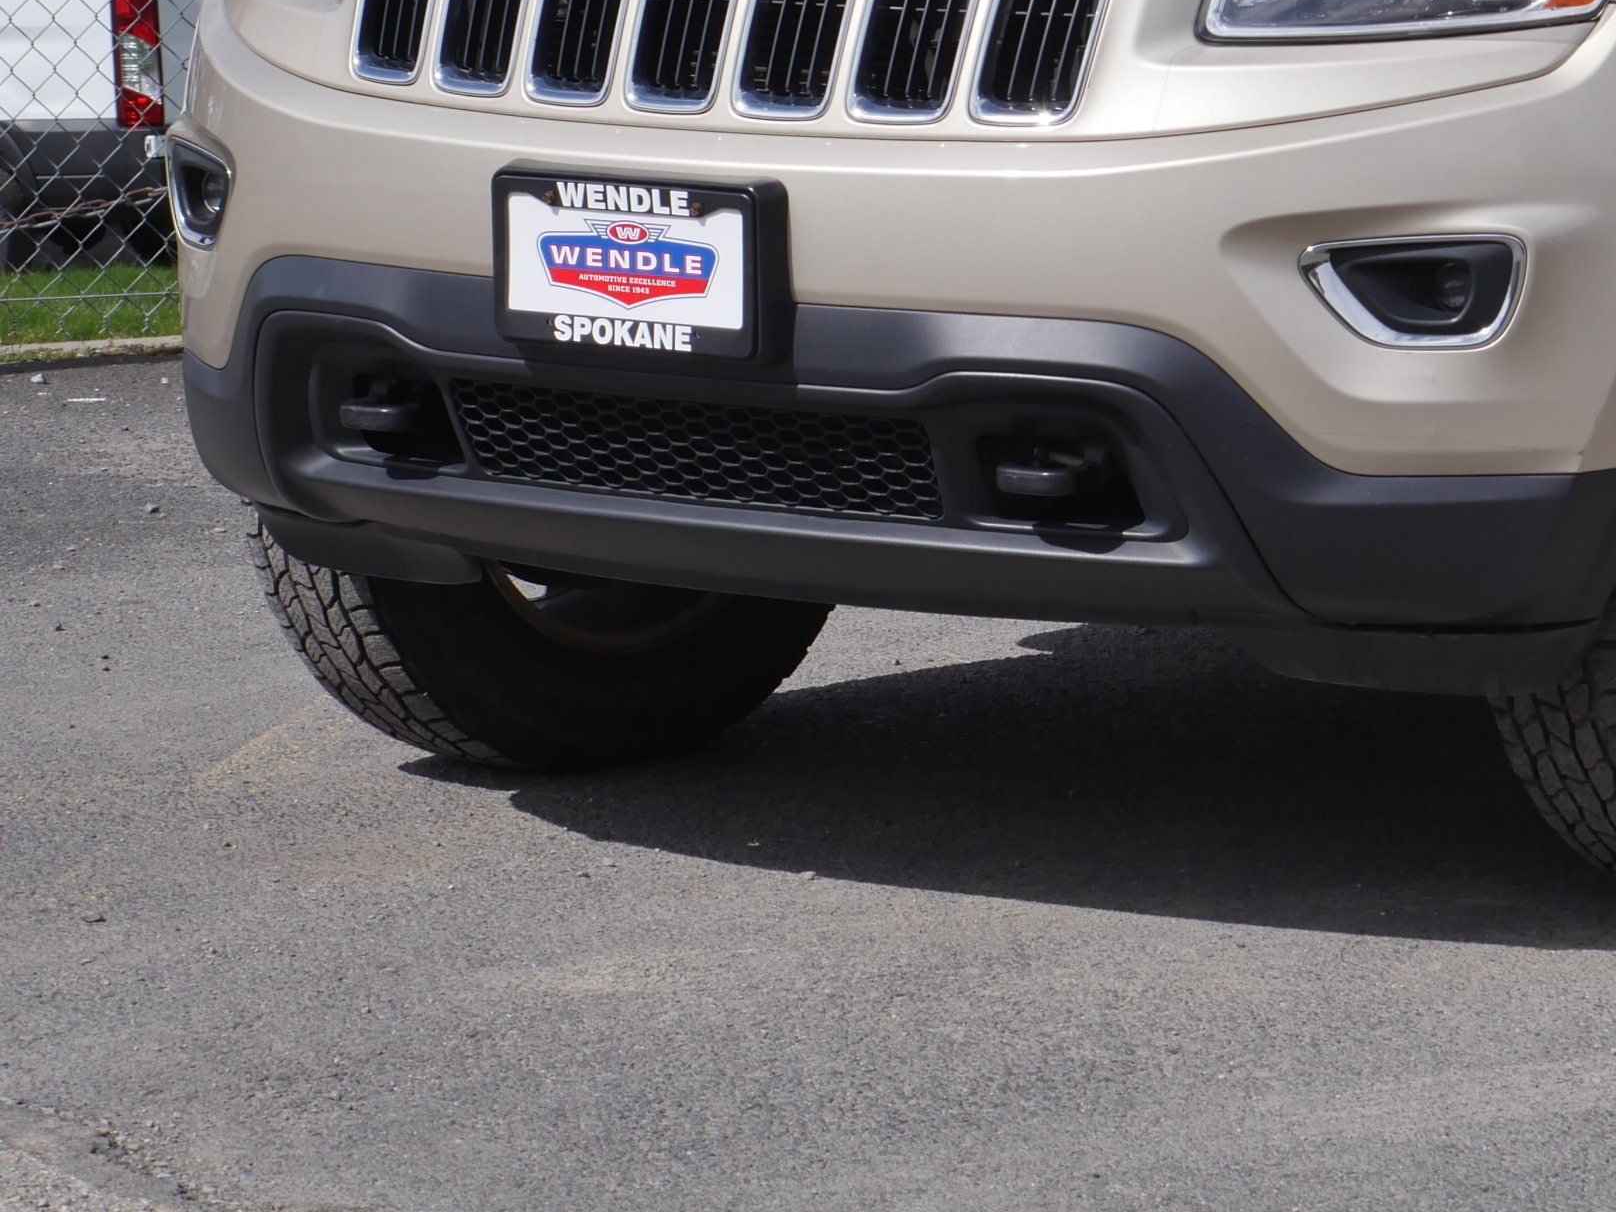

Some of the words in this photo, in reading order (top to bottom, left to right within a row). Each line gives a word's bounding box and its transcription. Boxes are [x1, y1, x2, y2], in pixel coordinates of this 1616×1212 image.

[555, 181, 690, 217] WENDLE
[550, 244, 702, 275] WENDLE
[578, 273, 628, 284] AUTOMOTIVE
[629, 277, 677, 288] EXCELLENCE
[607, 284, 630, 293] SINCE
[554, 314, 692, 352] SPOKANE
